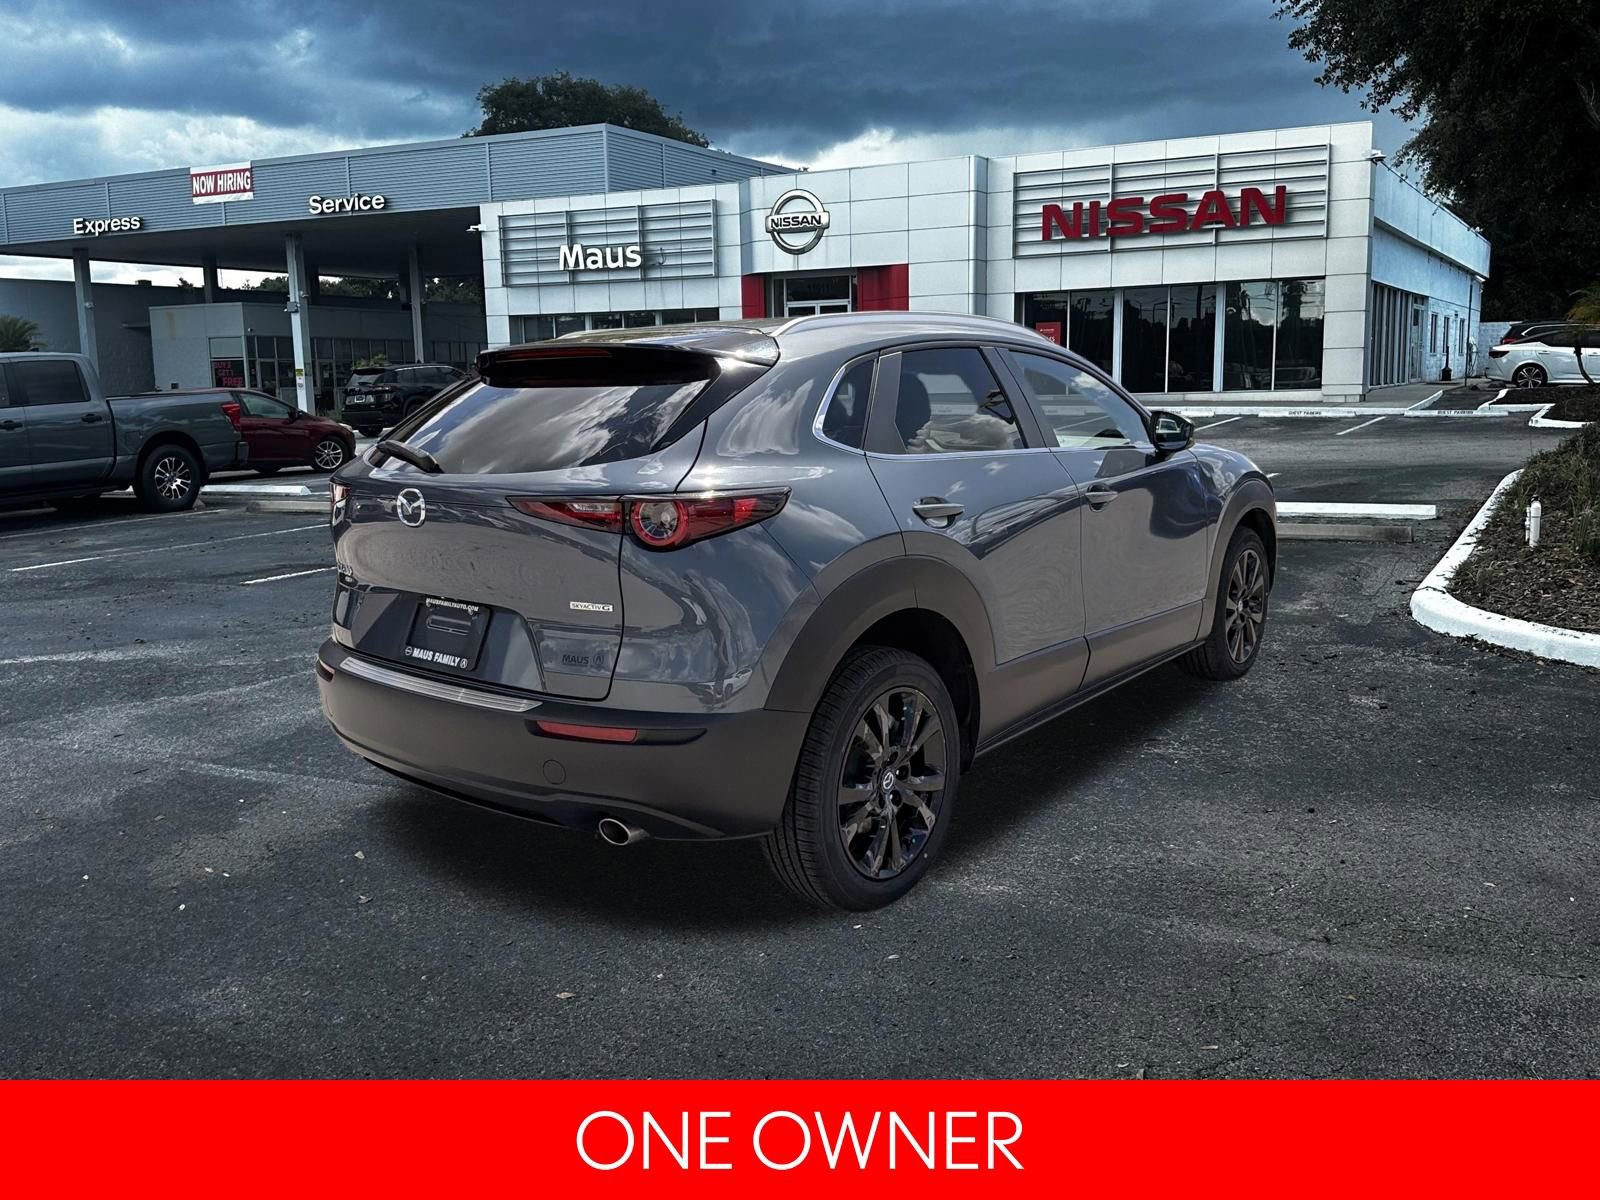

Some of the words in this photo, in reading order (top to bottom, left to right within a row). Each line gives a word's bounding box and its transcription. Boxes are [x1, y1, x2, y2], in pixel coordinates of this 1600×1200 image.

[192, 174, 215, 195] NOW
[217, 170, 251, 192] HIRING
[308, 193, 386, 215] Service
[1041, 185, 1287, 241] NISSAN
[73, 215, 141, 237] Express
[769, 214, 823, 230] NISSAN
[559, 243, 643, 271] Maus
[411, 647, 434, 661] MAUS
[433, 652, 461, 667] FAMILY
[561, 654, 589, 665] MAUS
